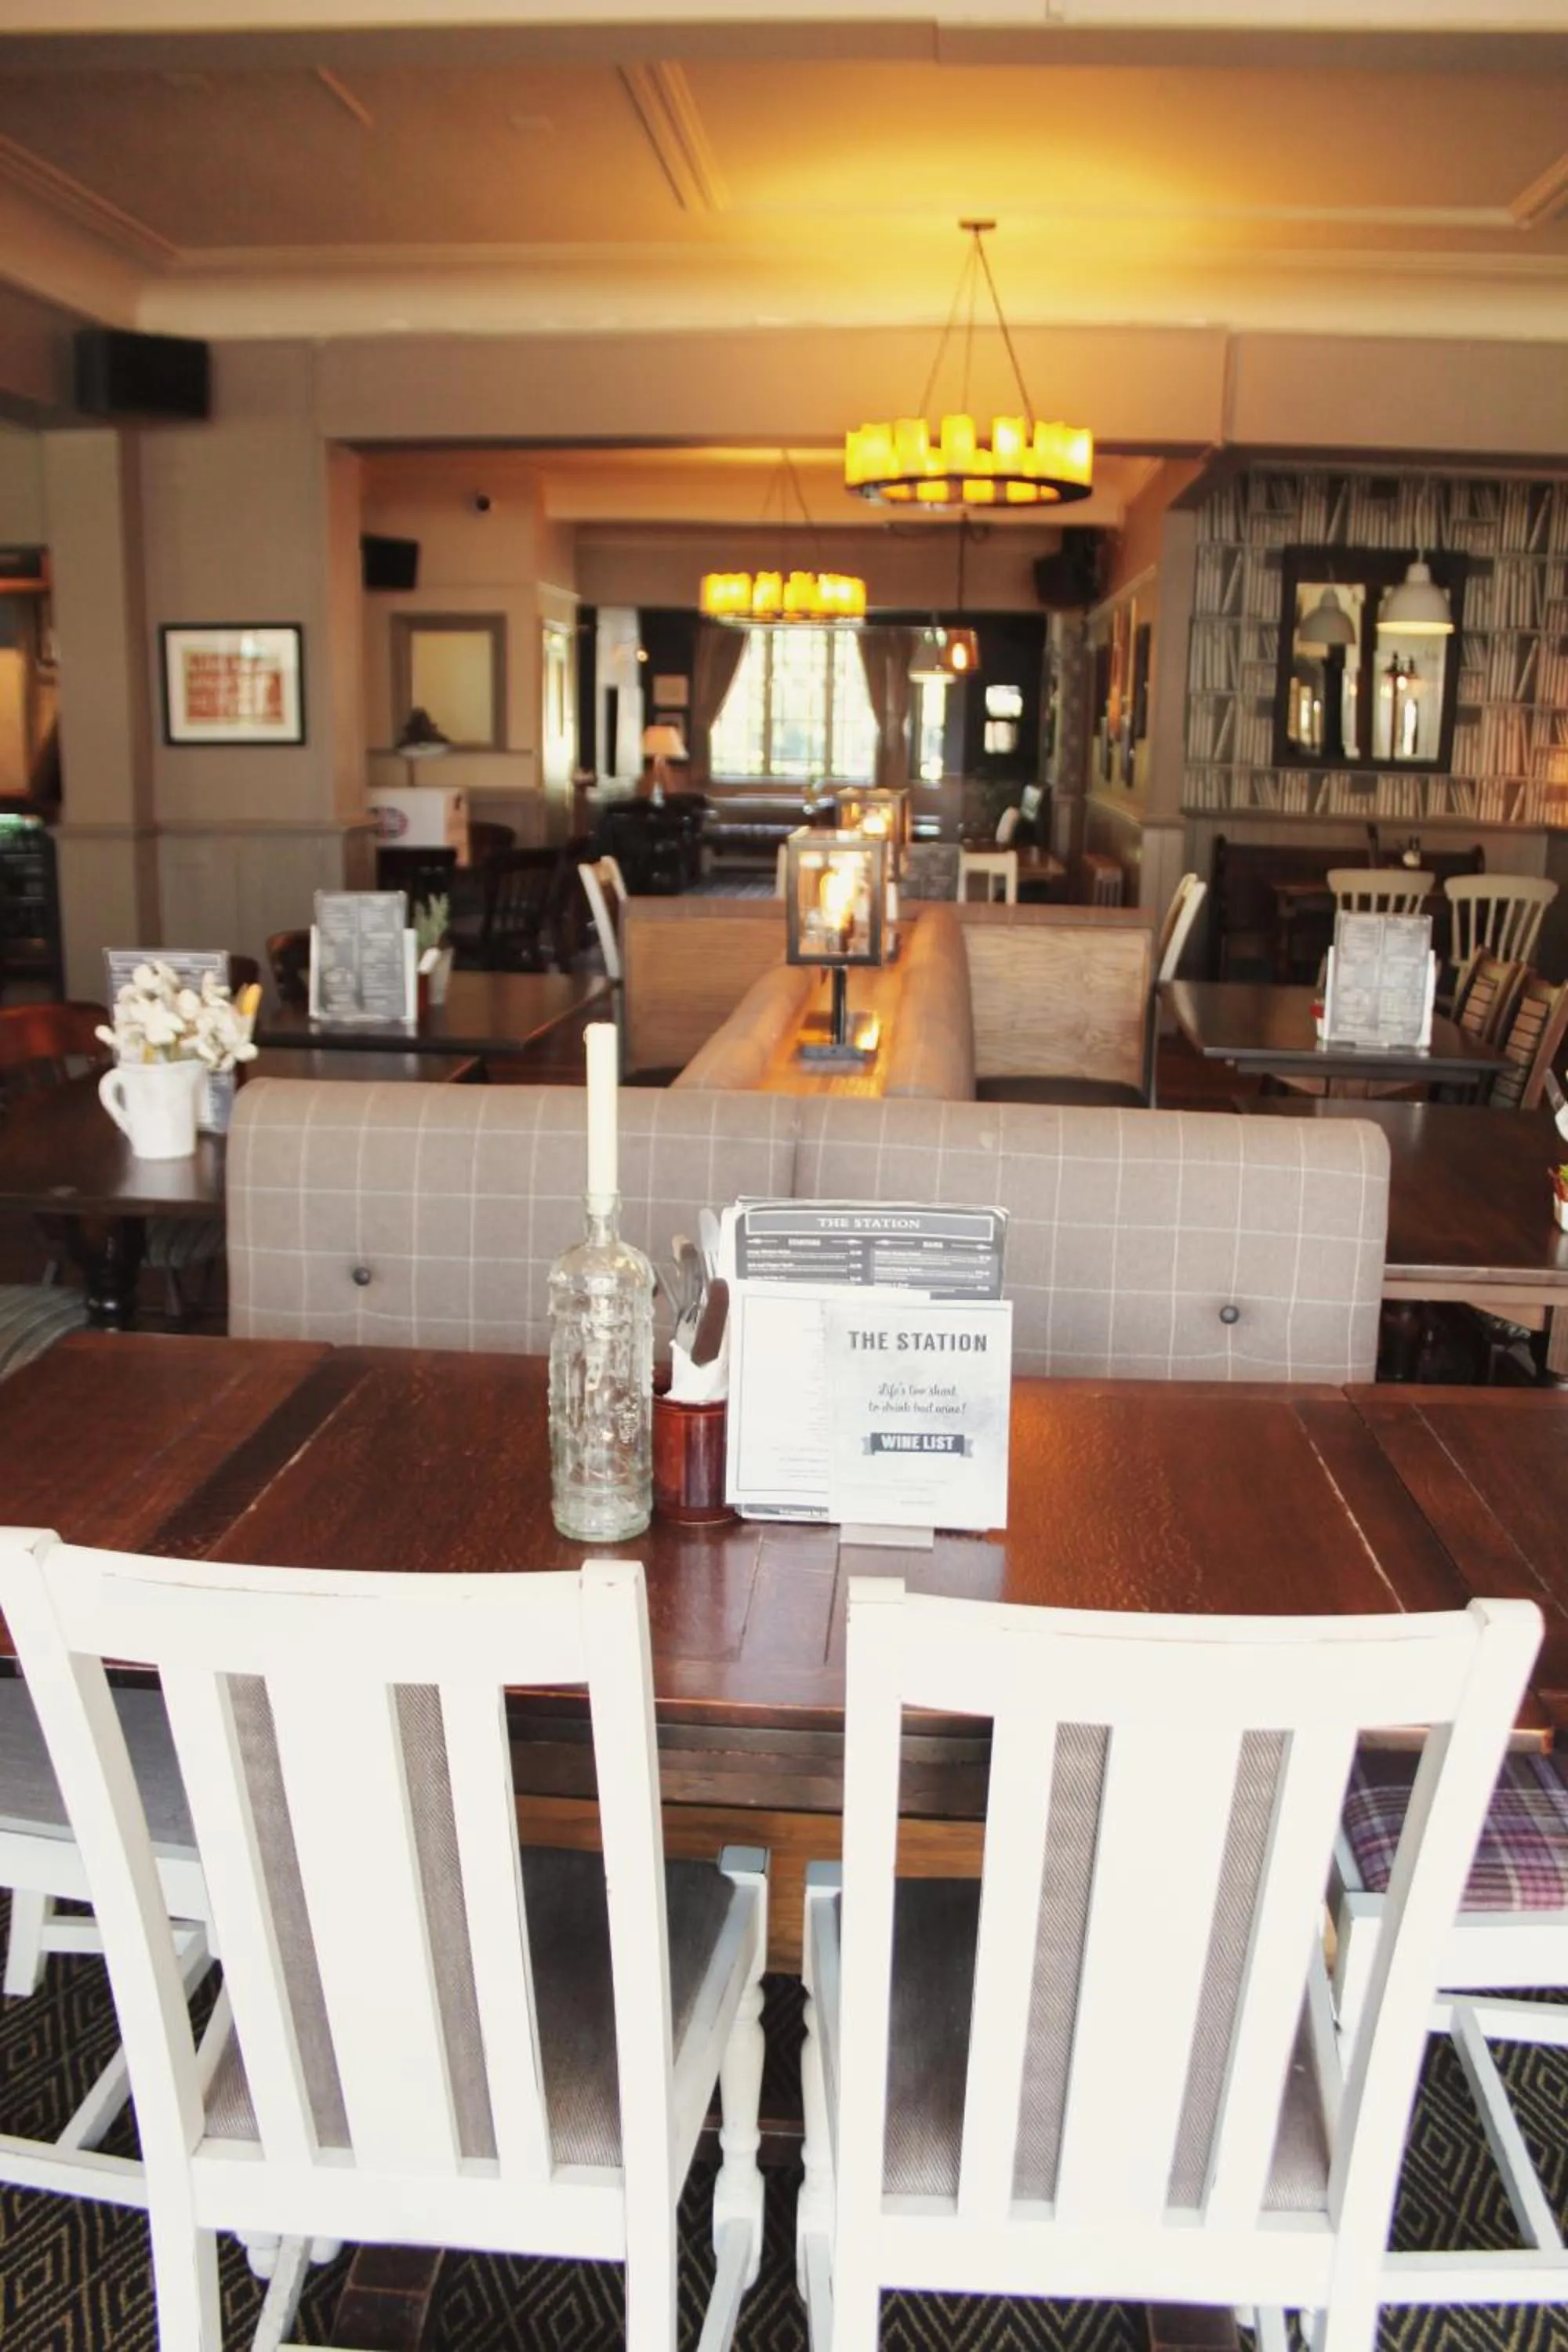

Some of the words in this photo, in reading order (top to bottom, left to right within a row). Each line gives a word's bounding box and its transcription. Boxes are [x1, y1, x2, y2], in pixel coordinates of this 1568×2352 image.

[817, 1218, 849, 1229] THE
[854, 1218, 920, 1229] STATION
[848, 1330, 889, 1350] THE
[897, 1332, 987, 1352] STATION
[880, 1434, 920, 1450] WINE
[923, 1435, 954, 1450] LIST
